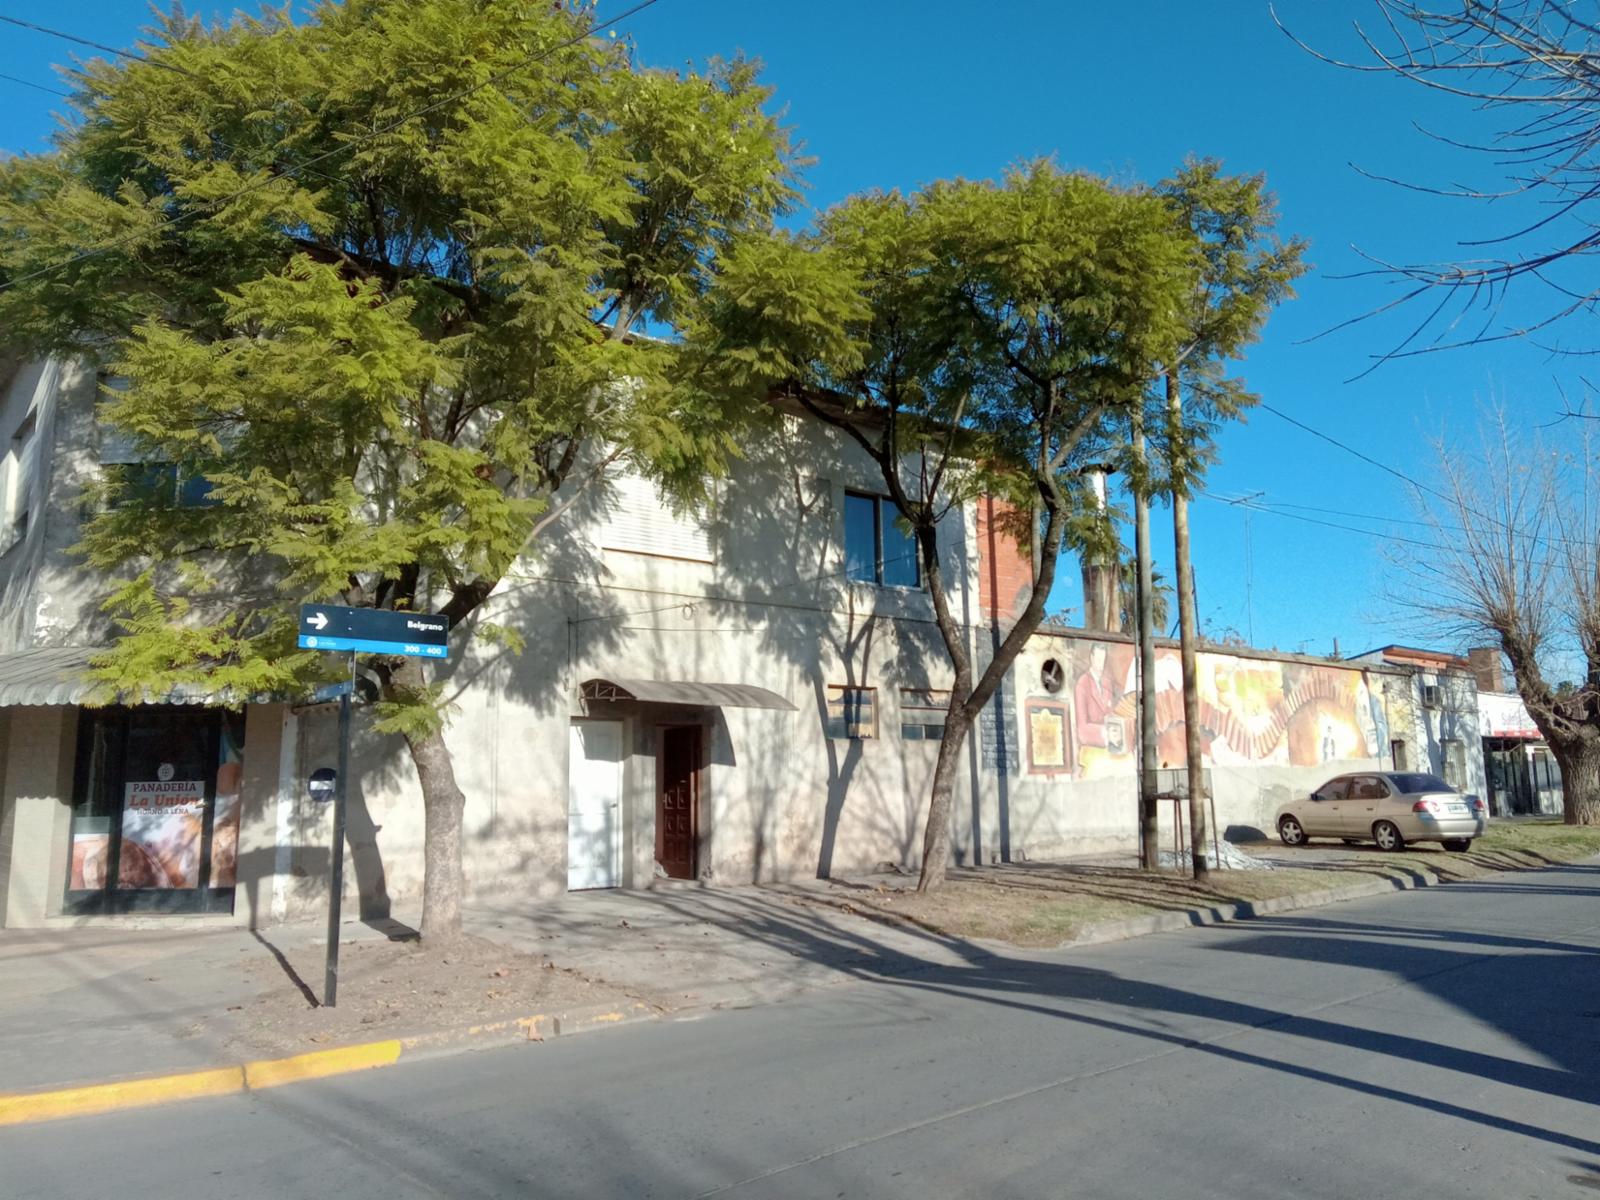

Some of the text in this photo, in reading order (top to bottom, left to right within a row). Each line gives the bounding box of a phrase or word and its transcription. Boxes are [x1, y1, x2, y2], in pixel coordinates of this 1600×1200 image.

[407, 620, 443, 631] Belgrano
[404, 645, 420, 653] 300
[427, 647, 442, 655] 400
[129, 795, 148, 807] La
